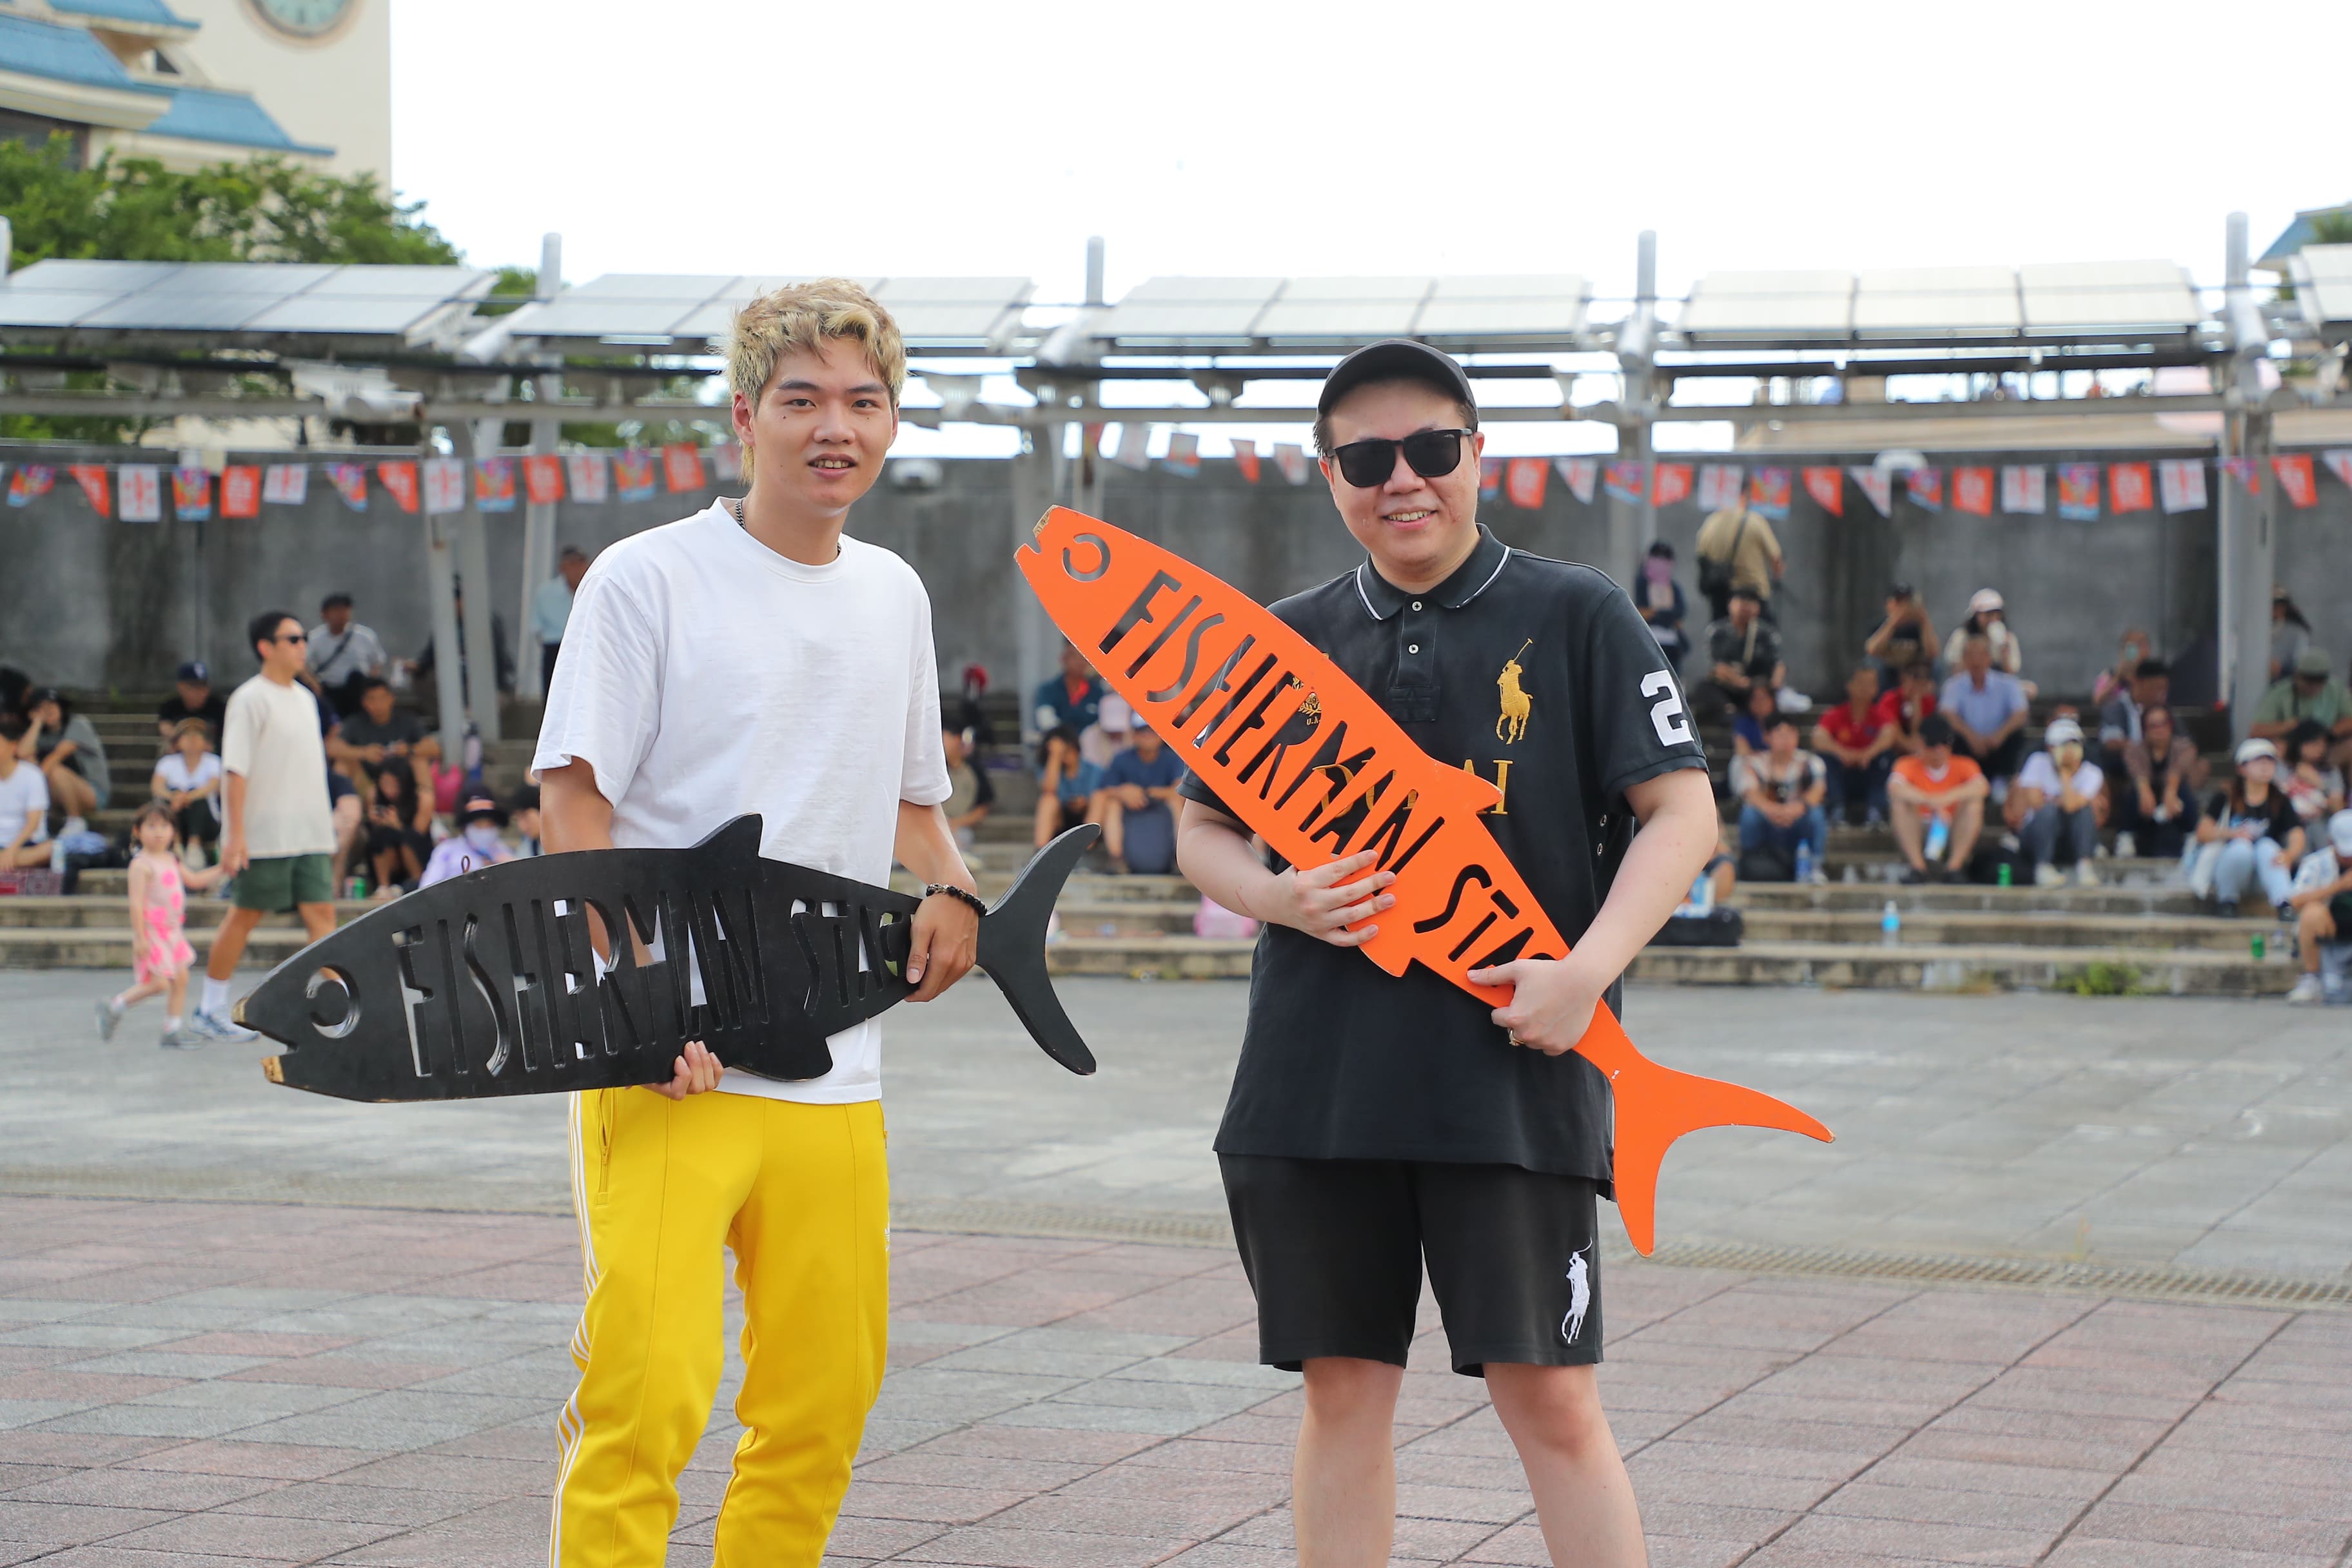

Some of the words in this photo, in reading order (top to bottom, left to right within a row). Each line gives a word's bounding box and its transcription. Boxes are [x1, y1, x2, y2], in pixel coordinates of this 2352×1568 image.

[1099, 569, 1445, 896] FISHERMAN
[1640, 669, 1694, 747] 2
[391, 890, 769, 1078] FISHERMAN
